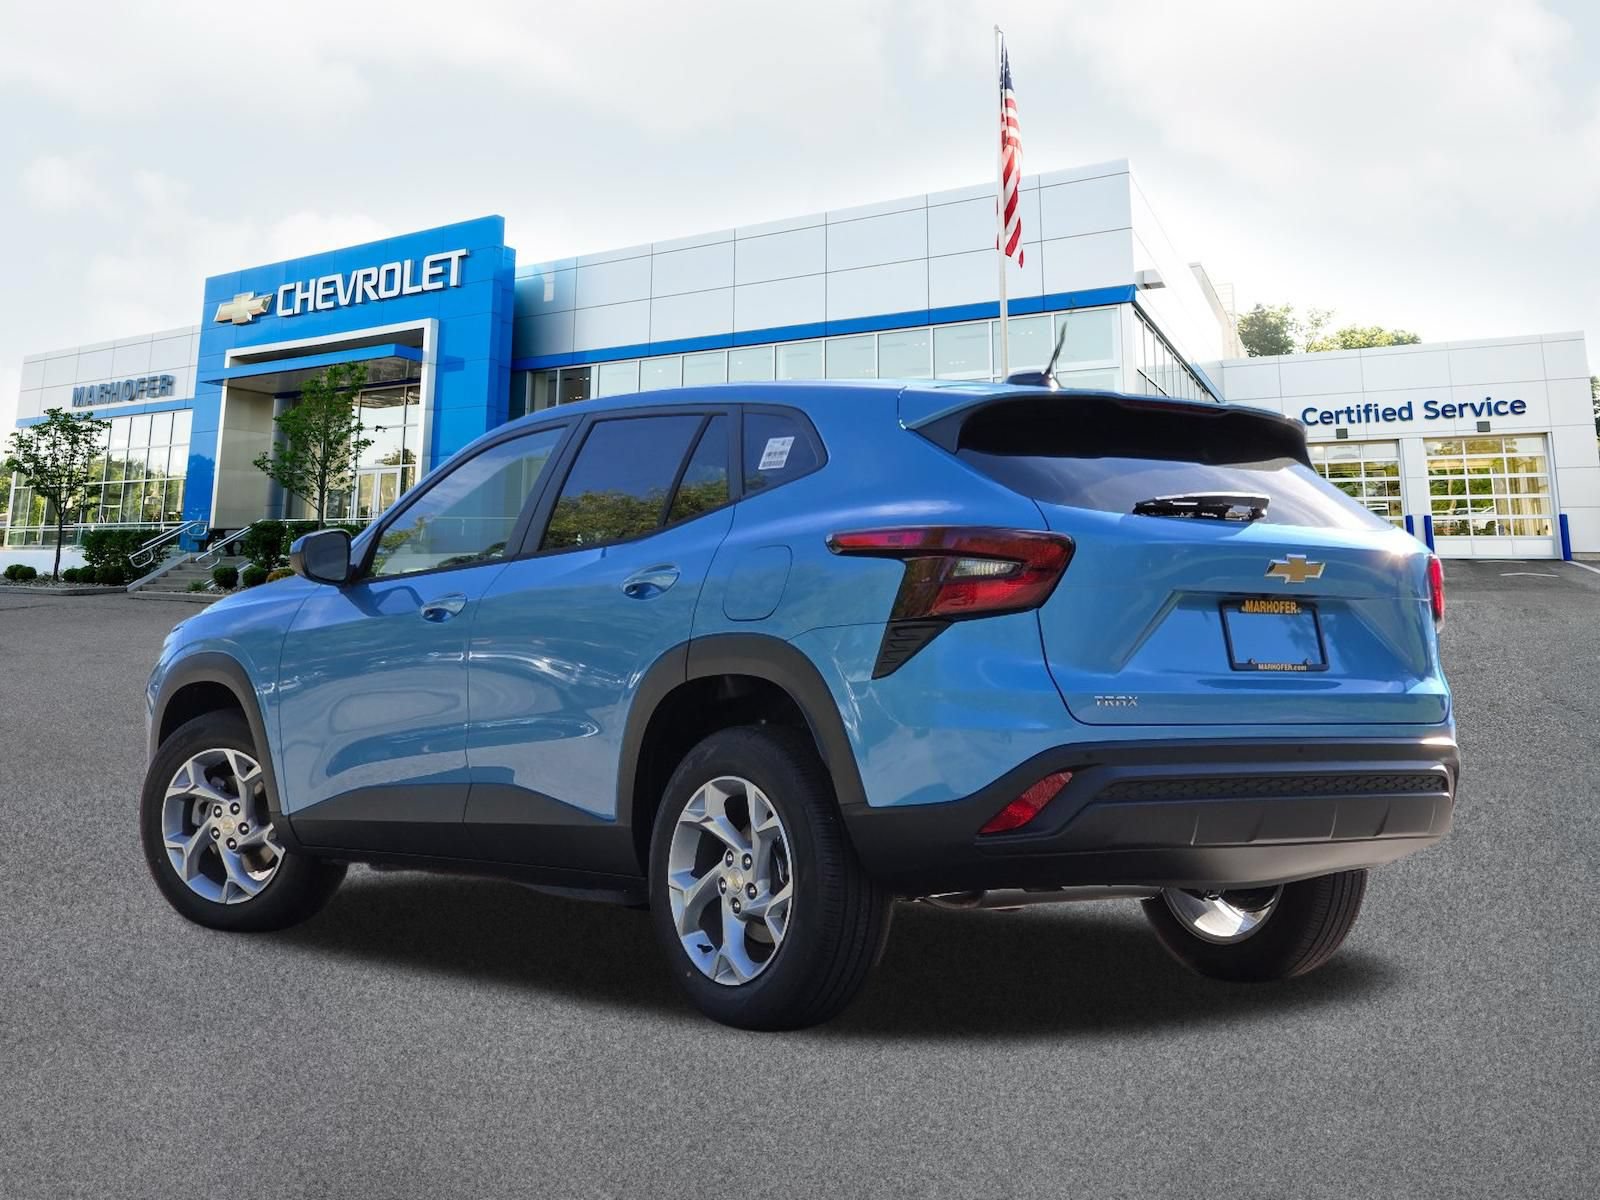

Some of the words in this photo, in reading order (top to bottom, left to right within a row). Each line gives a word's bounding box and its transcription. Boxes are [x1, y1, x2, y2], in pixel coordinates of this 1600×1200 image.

[276, 248, 469, 318] CHEVROLET
[72, 375, 176, 407] MARHOFER
[1301, 401, 1413, 426] Certified
[1423, 397, 1527, 420] Service
[1245, 600, 1297, 614] MARHOFER
[1094, 695, 1138, 707] TRAX
